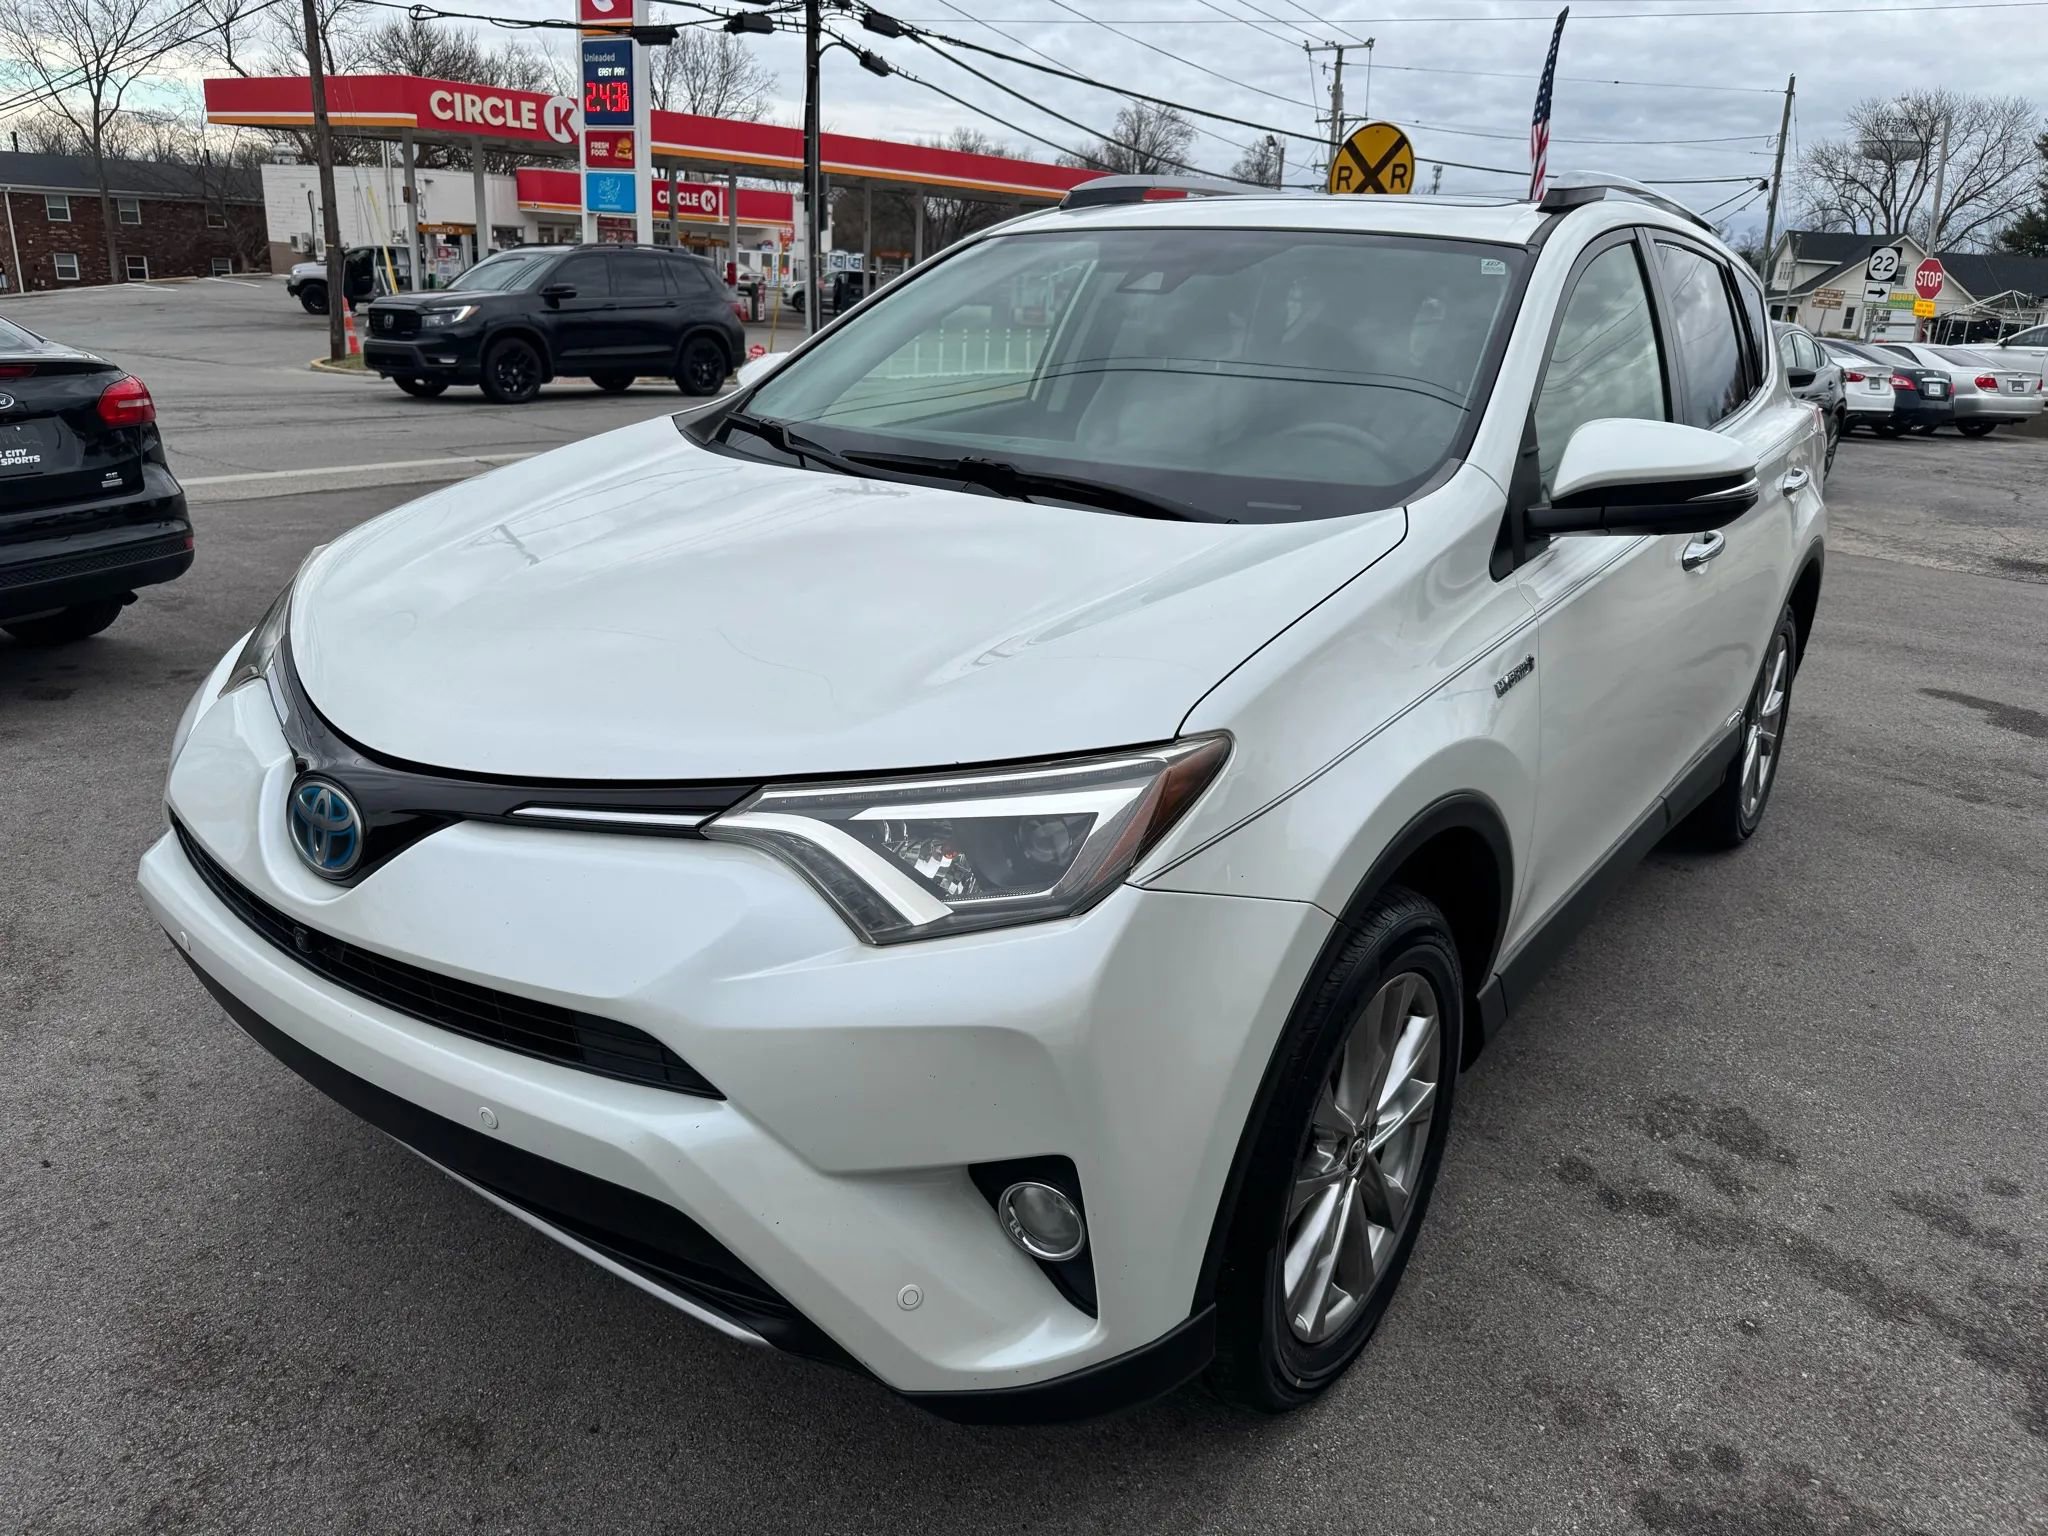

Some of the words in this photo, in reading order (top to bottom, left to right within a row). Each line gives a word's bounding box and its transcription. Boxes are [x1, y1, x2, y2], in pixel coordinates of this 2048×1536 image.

[584, 52, 616, 62] Unleaded
[598, 67, 612, 76] EASY
[614, 67, 626, 76] PAY
[429, 90, 538, 130] CIRCLE
[552, 103, 579, 142] K
[590, 141, 610, 149] FRESH
[657, 190, 699, 207] CICLE
[1872, 255, 1895, 272] 22
[1916, 270, 1943, 288] STOP
[5, 449, 27, 457] CITY
[1, 455, 41, 466] SPORTS
